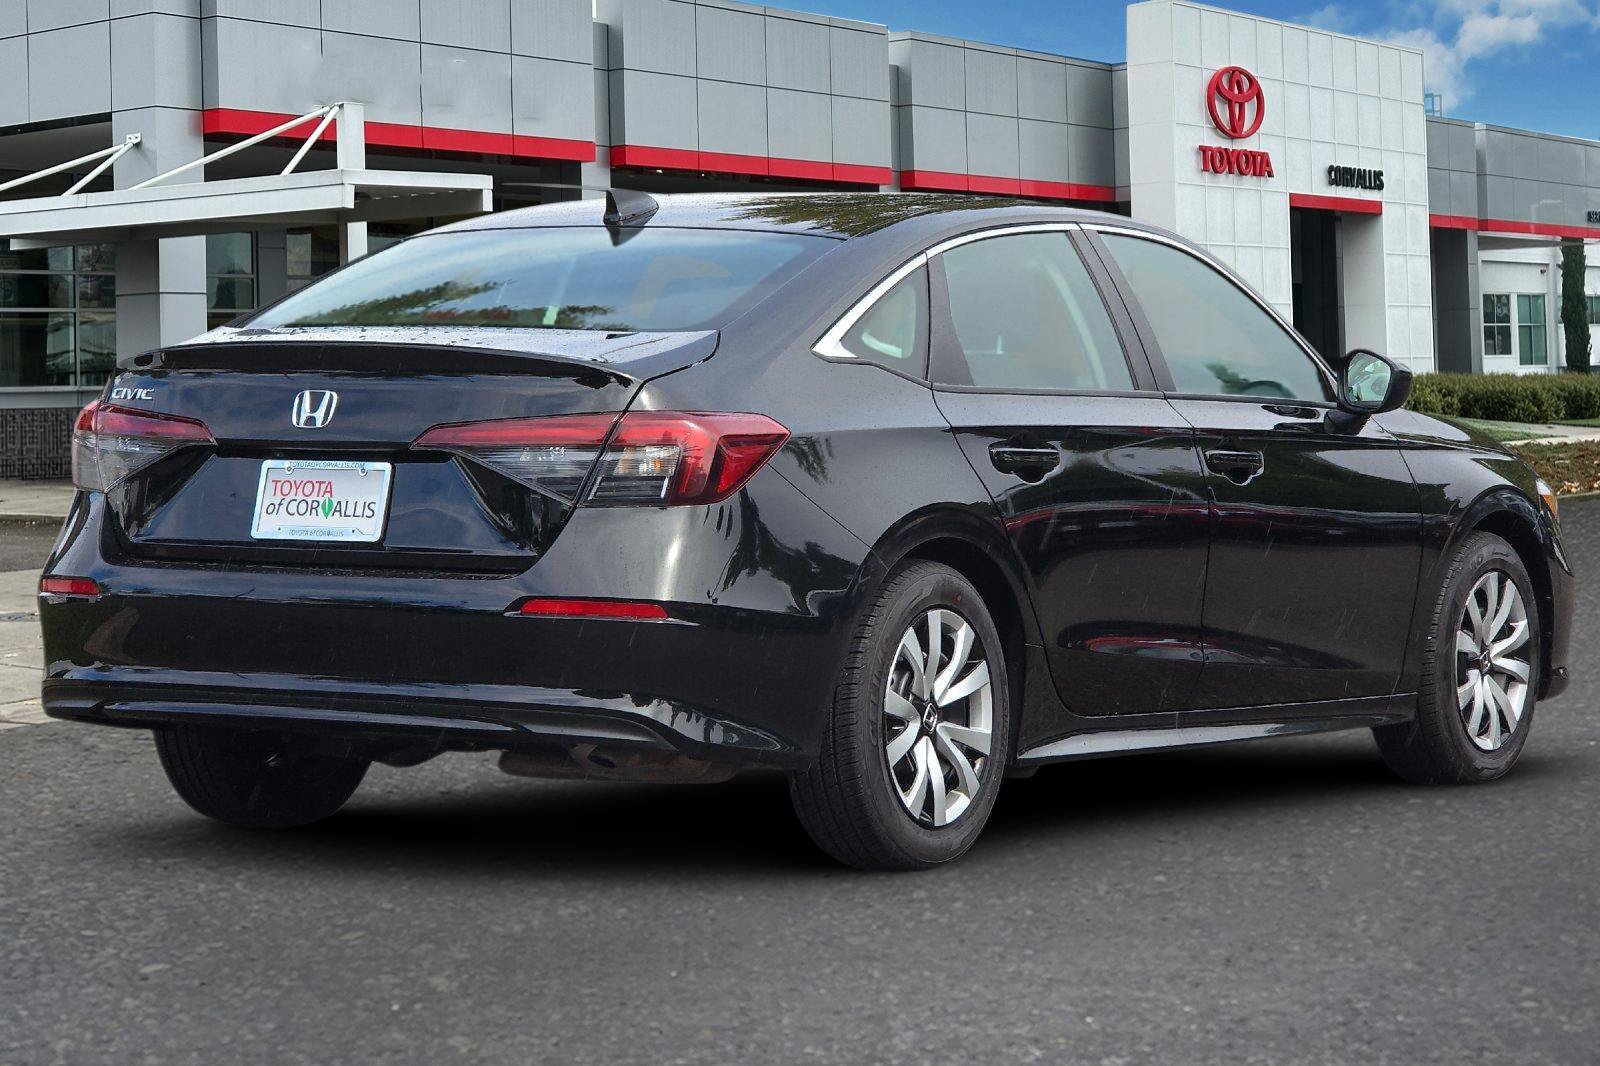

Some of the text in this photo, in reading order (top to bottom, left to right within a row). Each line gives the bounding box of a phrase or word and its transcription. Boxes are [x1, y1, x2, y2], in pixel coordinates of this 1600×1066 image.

[1199, 144, 1274, 178] TOYOTA
[1327, 164, 1385, 191] CORVALLIS
[111, 387, 155, 400] CIVIC
[271, 479, 334, 498] TOYOTA
[265, 498, 284, 516] of
